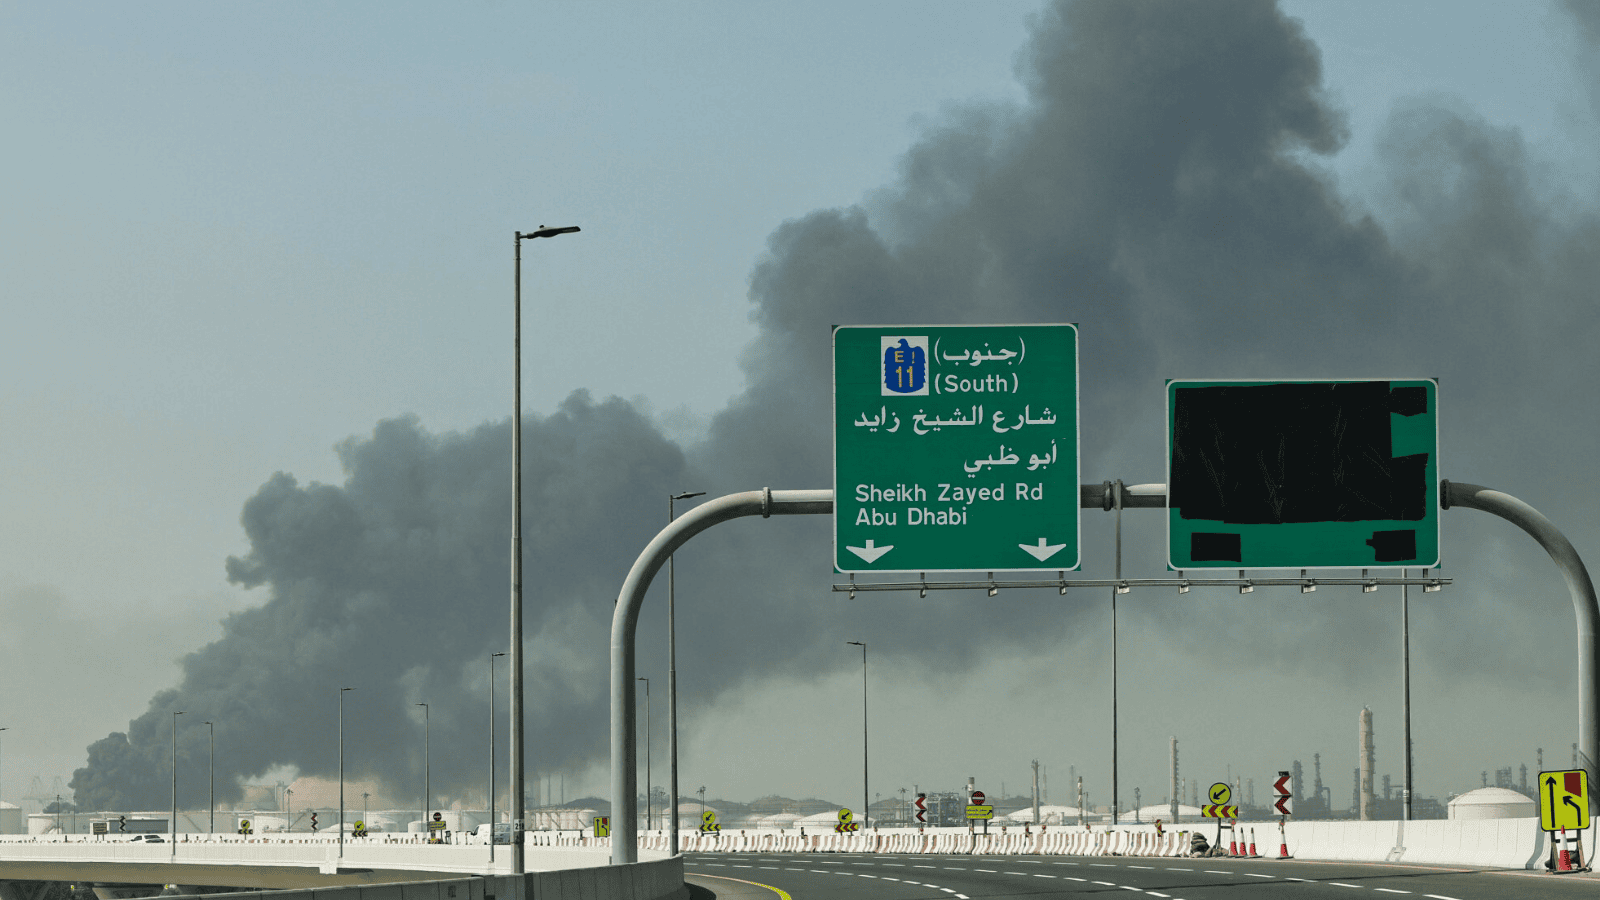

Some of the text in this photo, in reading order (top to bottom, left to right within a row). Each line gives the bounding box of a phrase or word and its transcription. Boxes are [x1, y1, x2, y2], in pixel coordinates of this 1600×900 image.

[894, 350, 905, 363] E
[935, 337, 1025, 366] (جنوب)
[895, 366, 914, 388] 11
[935, 373, 1018, 394] (South)
[854, 405, 1057, 435] شارع الشيخ زايد
[964, 439, 1057, 478] أبو ظبي
[855, 483, 1043, 505] Sheikh Zayed Rd
[855, 507, 967, 525] Abu Dhabi
